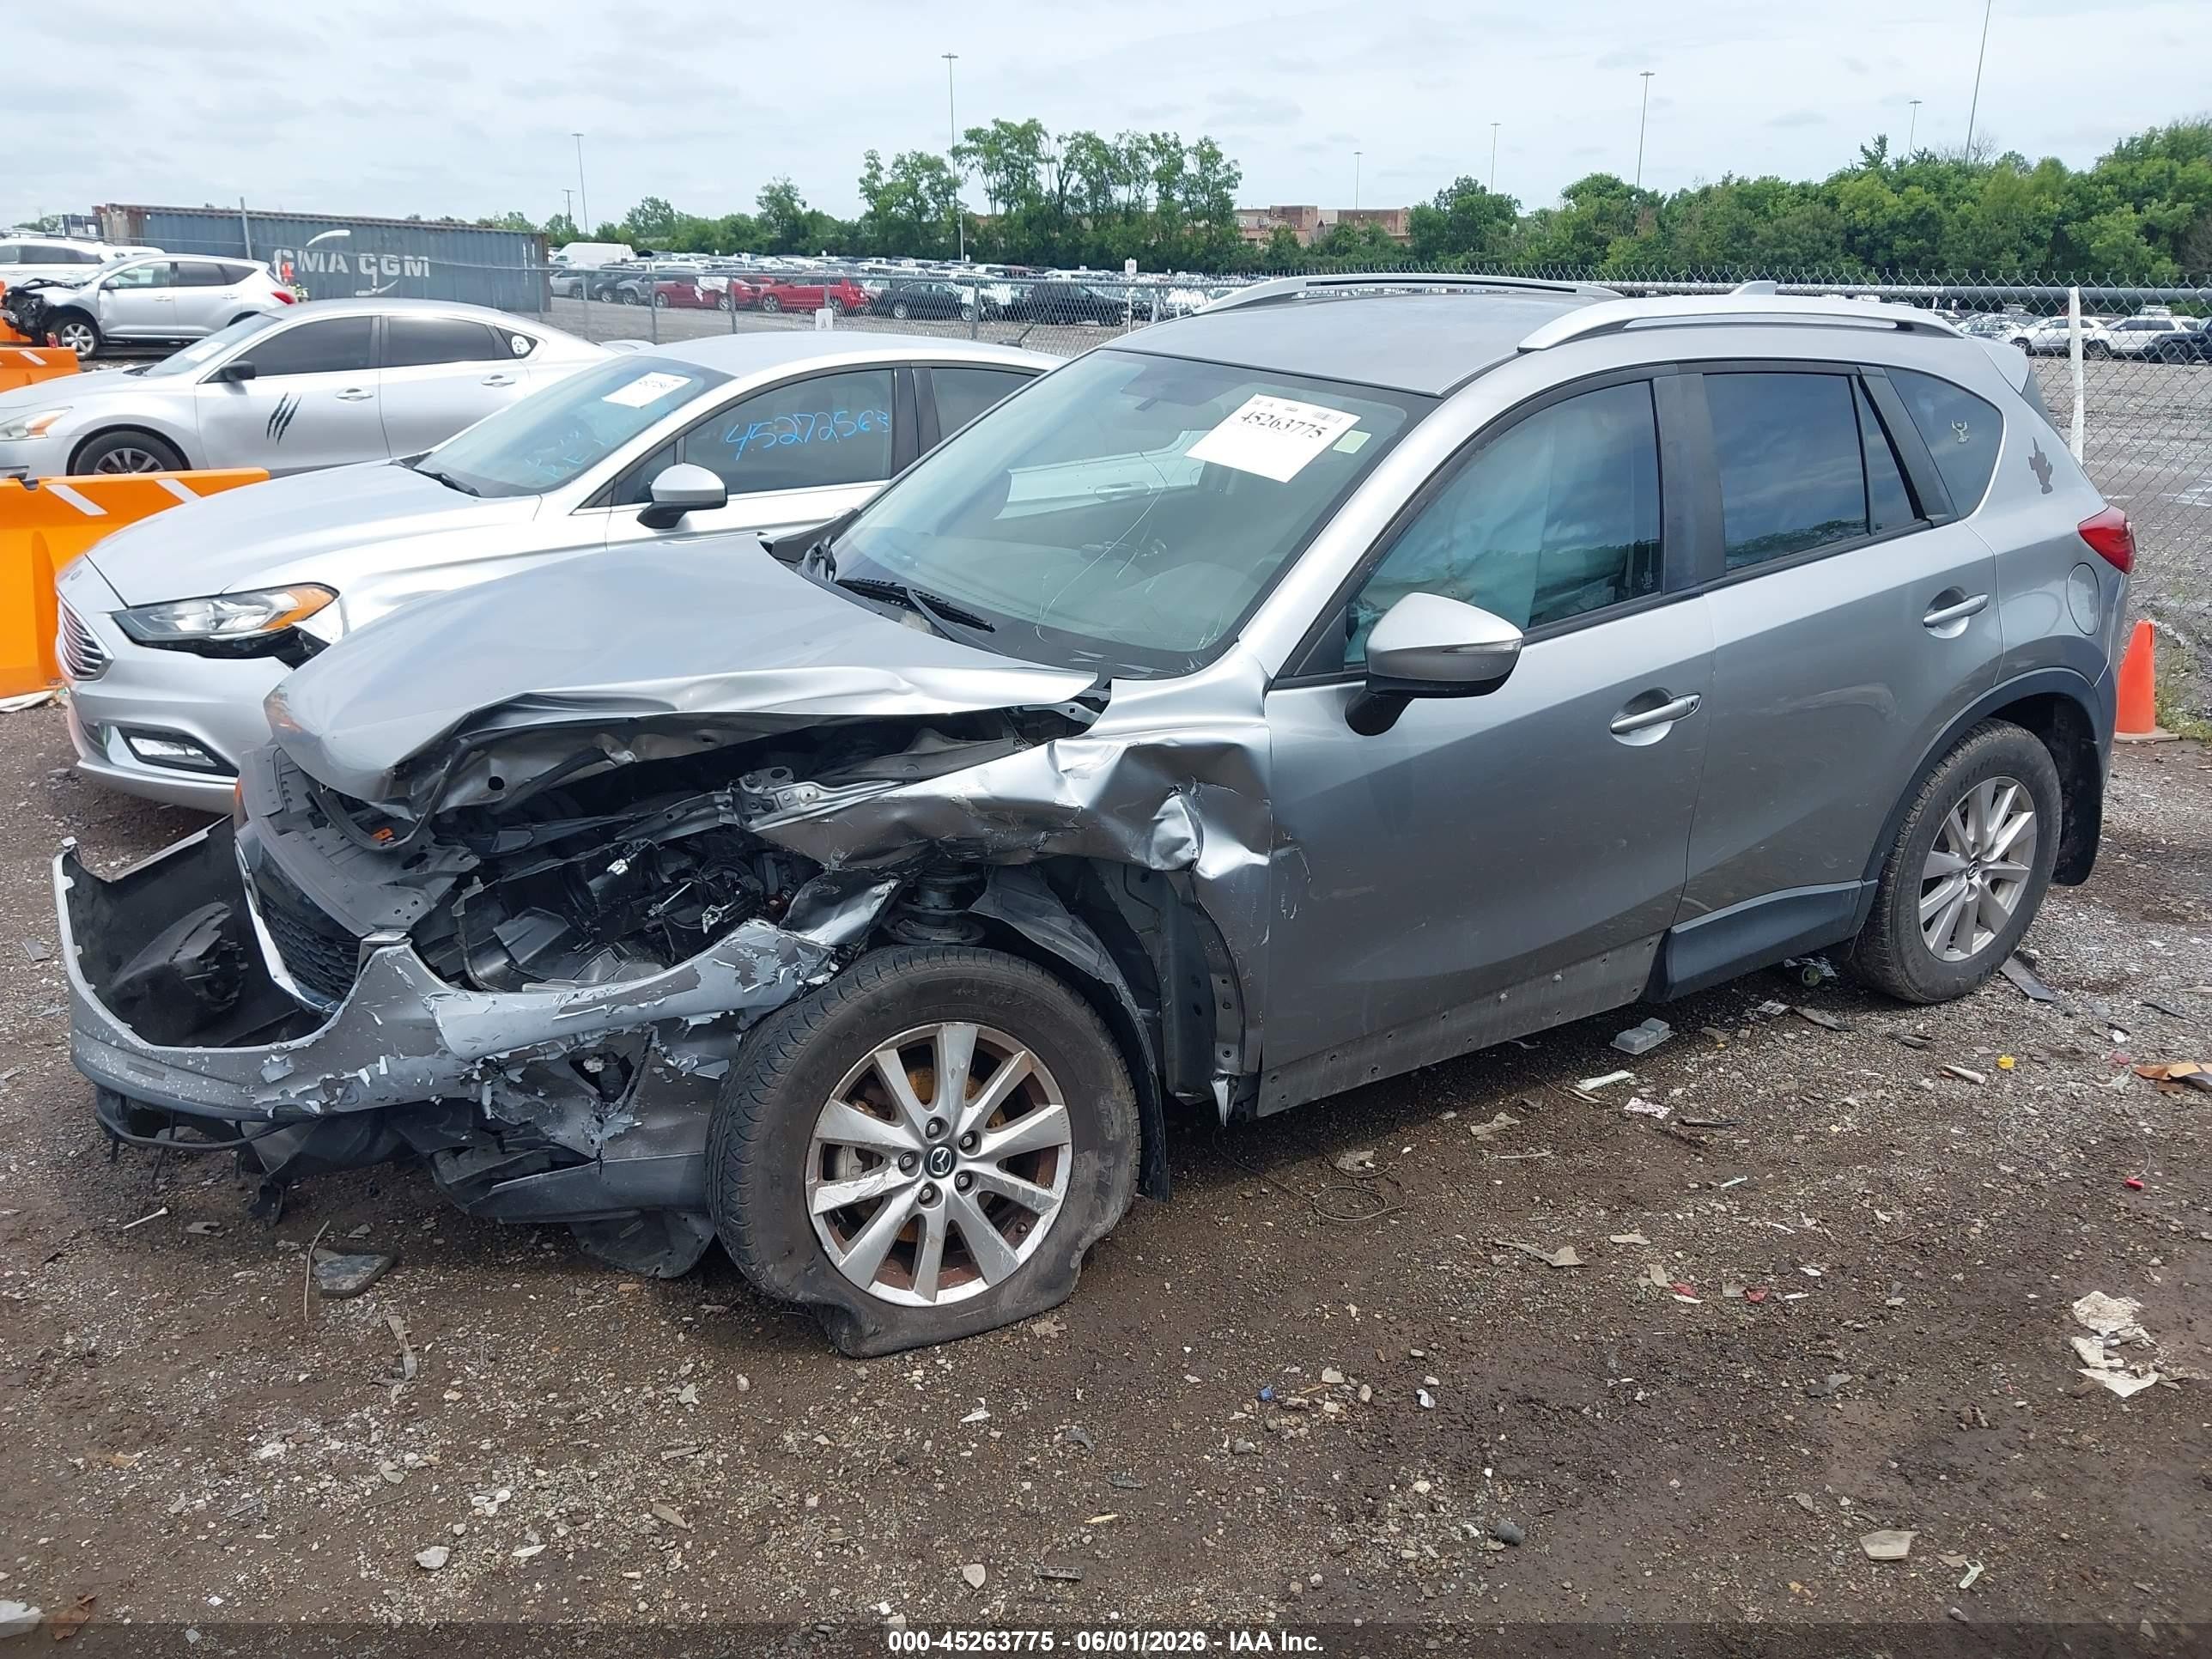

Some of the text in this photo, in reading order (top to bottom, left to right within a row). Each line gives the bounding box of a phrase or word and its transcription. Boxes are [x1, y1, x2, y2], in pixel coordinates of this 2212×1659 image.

[357, 252, 430, 277] CGM
[726, 410, 891, 461] 45272563
[1241, 410, 1328, 439] 45263775
